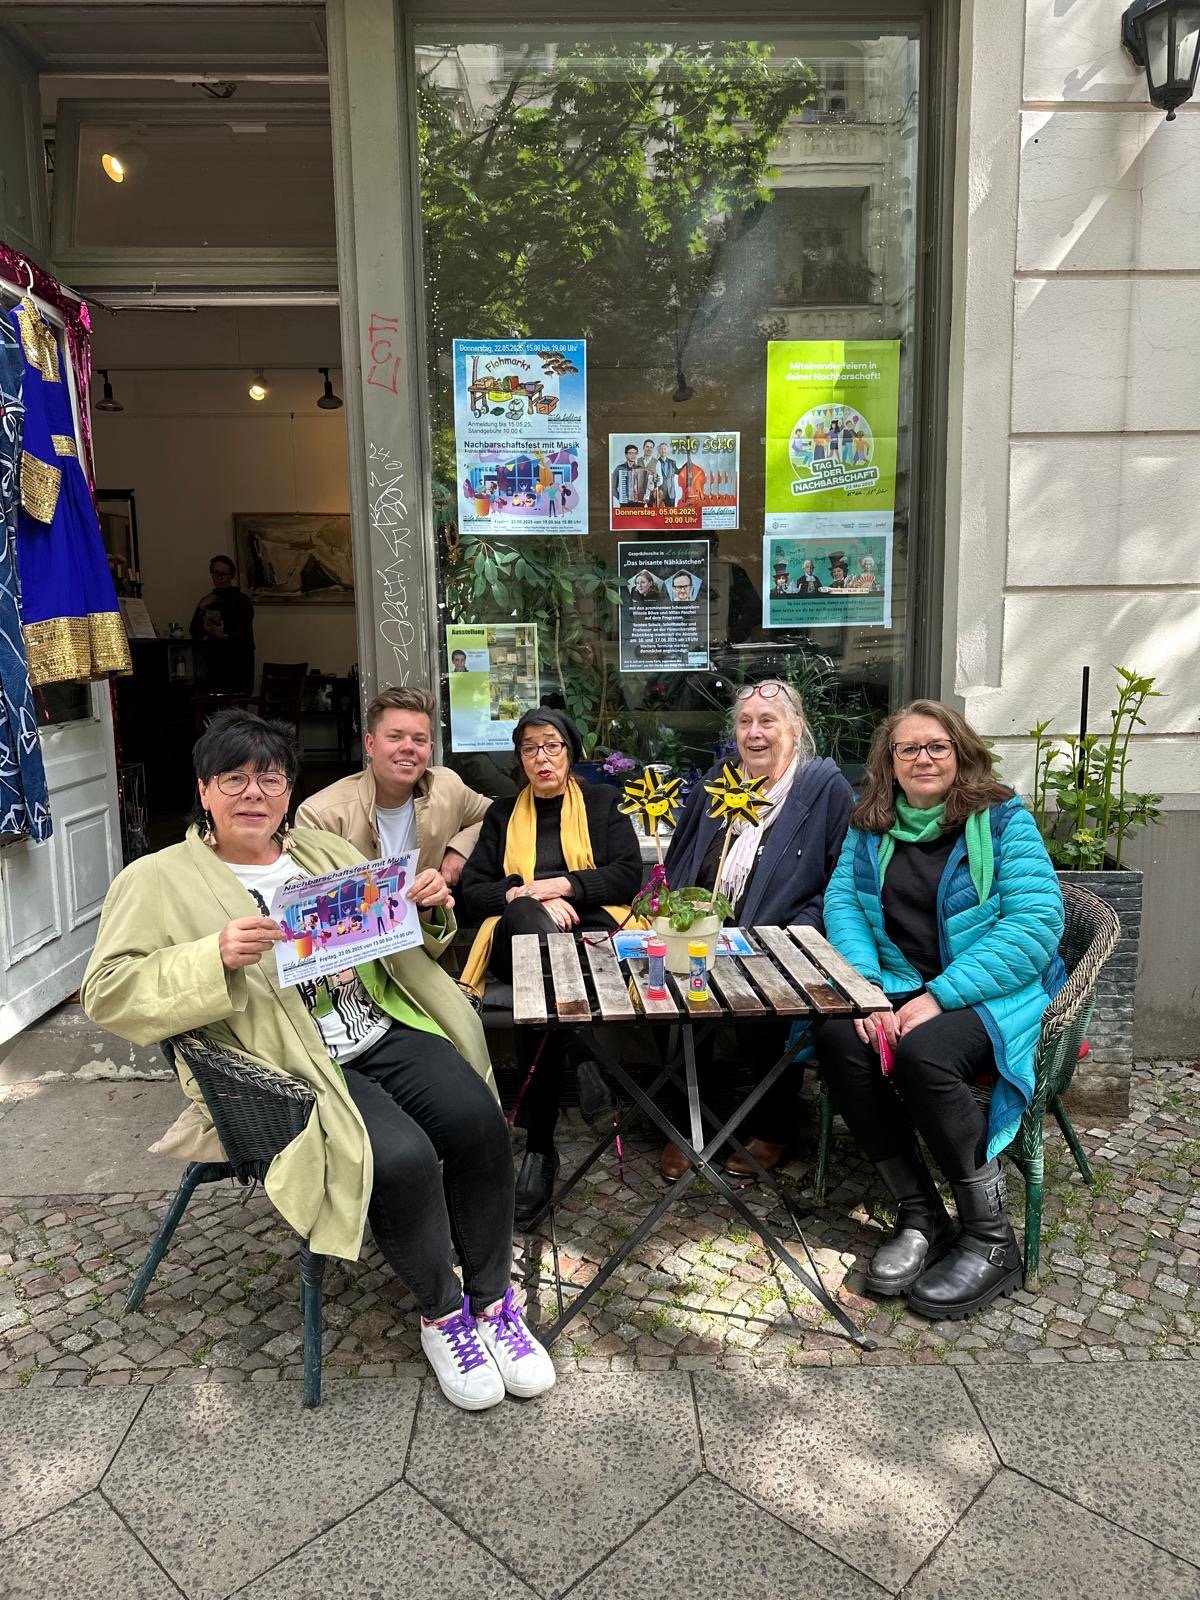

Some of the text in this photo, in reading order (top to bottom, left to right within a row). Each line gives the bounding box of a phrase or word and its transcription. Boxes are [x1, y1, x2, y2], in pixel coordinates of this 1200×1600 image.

[460, 345, 494, 353] Donnerstag,
[484, 357, 530, 372] Flohmarkt
[790, 362, 841, 370] Miteinander
[814, 372, 881, 380] Nachbarschaft!
[813, 462, 832, 471] TAG
[823, 469, 842, 478] DER
[794, 470, 875, 492] NACHBARSCHAFT
[615, 508, 698, 517] Donnerstag, 05.06.2025,
[284, 864, 370, 892] Nachbarschaftsfest
[388, 854, 411, 864] Musik
[319, 953, 338, 962] Freitag,
